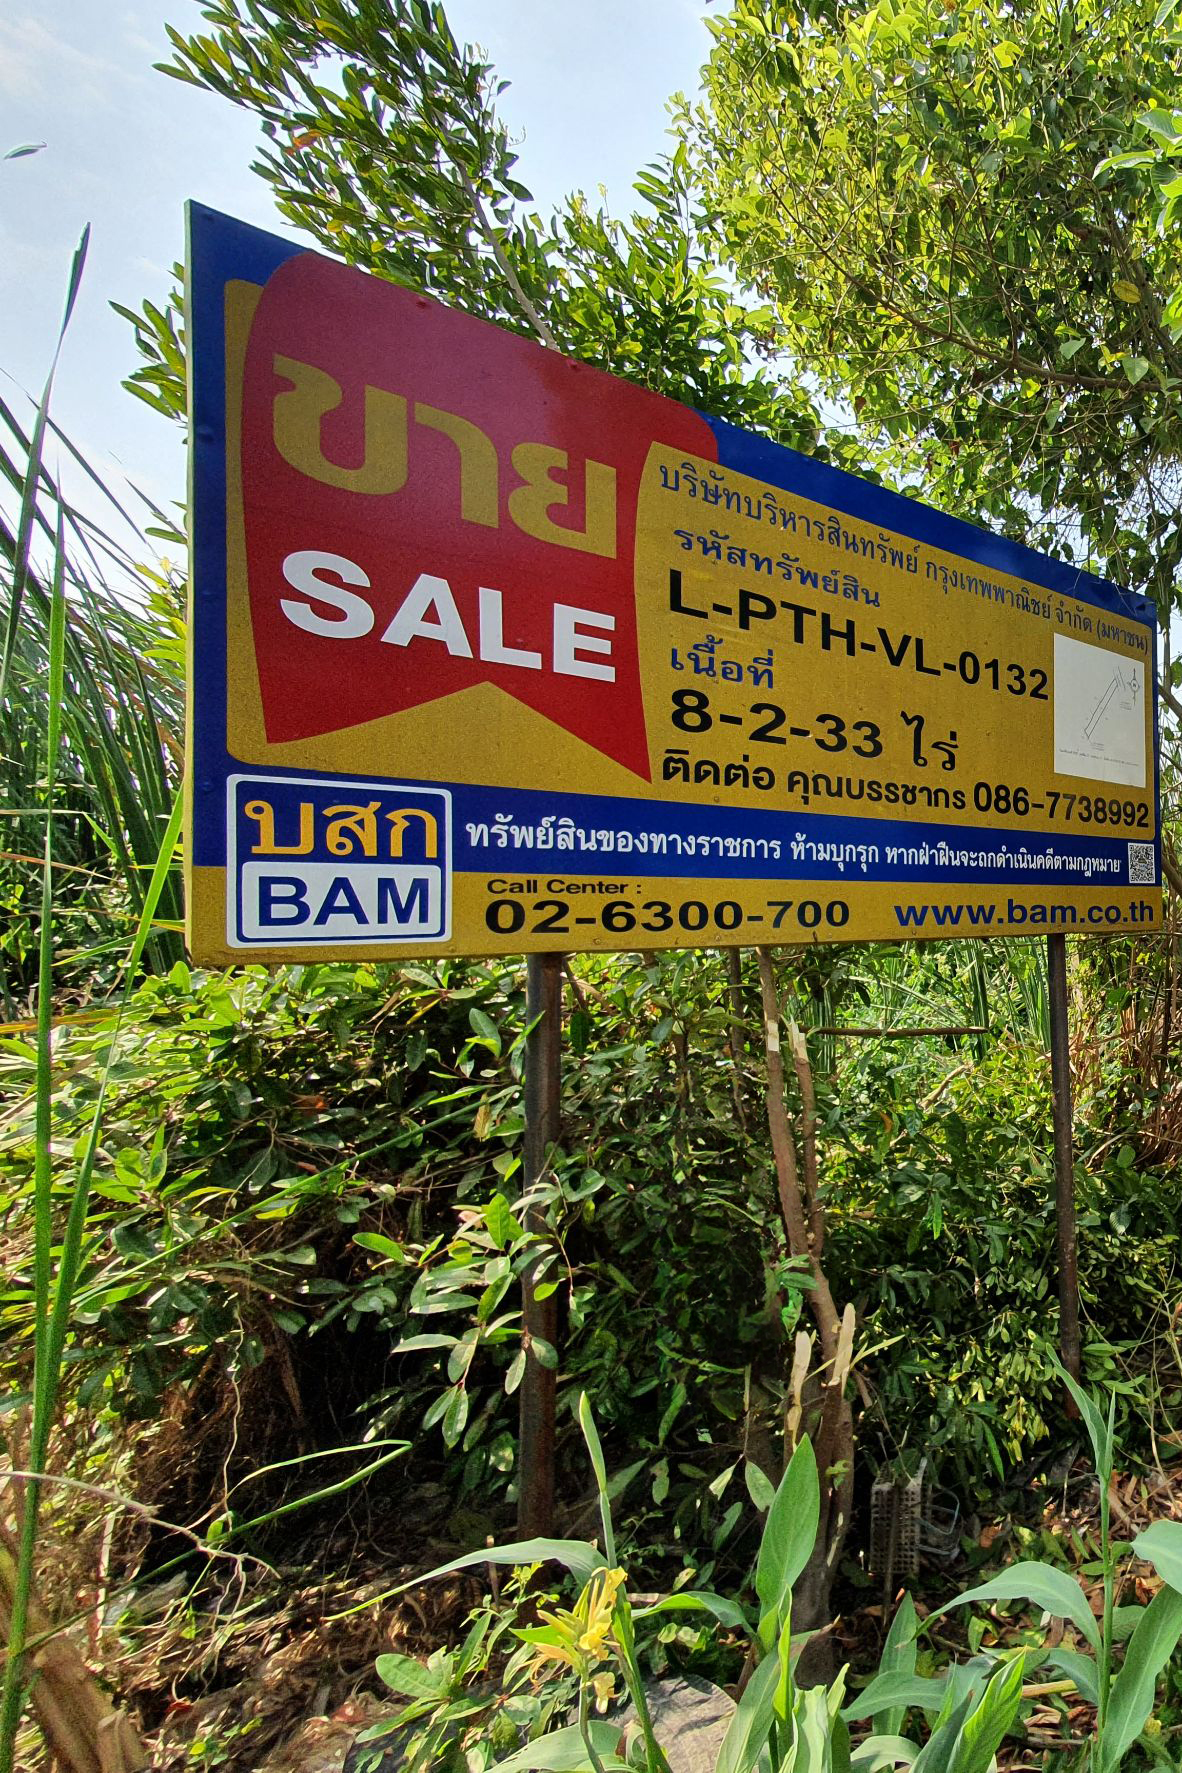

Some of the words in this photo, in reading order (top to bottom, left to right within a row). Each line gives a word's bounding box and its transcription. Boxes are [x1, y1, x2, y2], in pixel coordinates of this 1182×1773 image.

[273, 353, 617, 560] ขาย
[660, 462, 920, 574] บริษัทบริหารสินทรัพย์
[926, 561, 1053, 619] กรุงเทพพาณิชย์
[1055, 600, 1093, 633] จำกัด
[1096, 619, 1149, 655] (มหาชน)
[674, 529, 880, 608] รหัสทรัพย์สิน
[280, 550, 616, 683] SALE
[669, 568, 1050, 701] L-PTH-VL-0132
[671, 634, 775, 690] เนื้อที่
[671, 688, 884, 759] 8-2-33
[901, 711, 959, 772] ไร่
[662, 748, 776, 792] ติดต่อ
[787, 768, 967, 811] คุณบรรชากร
[973, 781, 1150, 829] 086-7738992
[244, 799, 438, 859] บสก
[465, 813, 782, 860] ทรัพย์สินของทางราชการ
[790, 831, 880, 873] ห้ามบุกรุก
[258, 875, 430, 928] BAM
[484, 900, 851, 935] 02-6300-700
[486, 878, 539, 895] Call
[546, 879, 629, 895] Center
[894, 898, 1155, 928] www.bam.co.th
